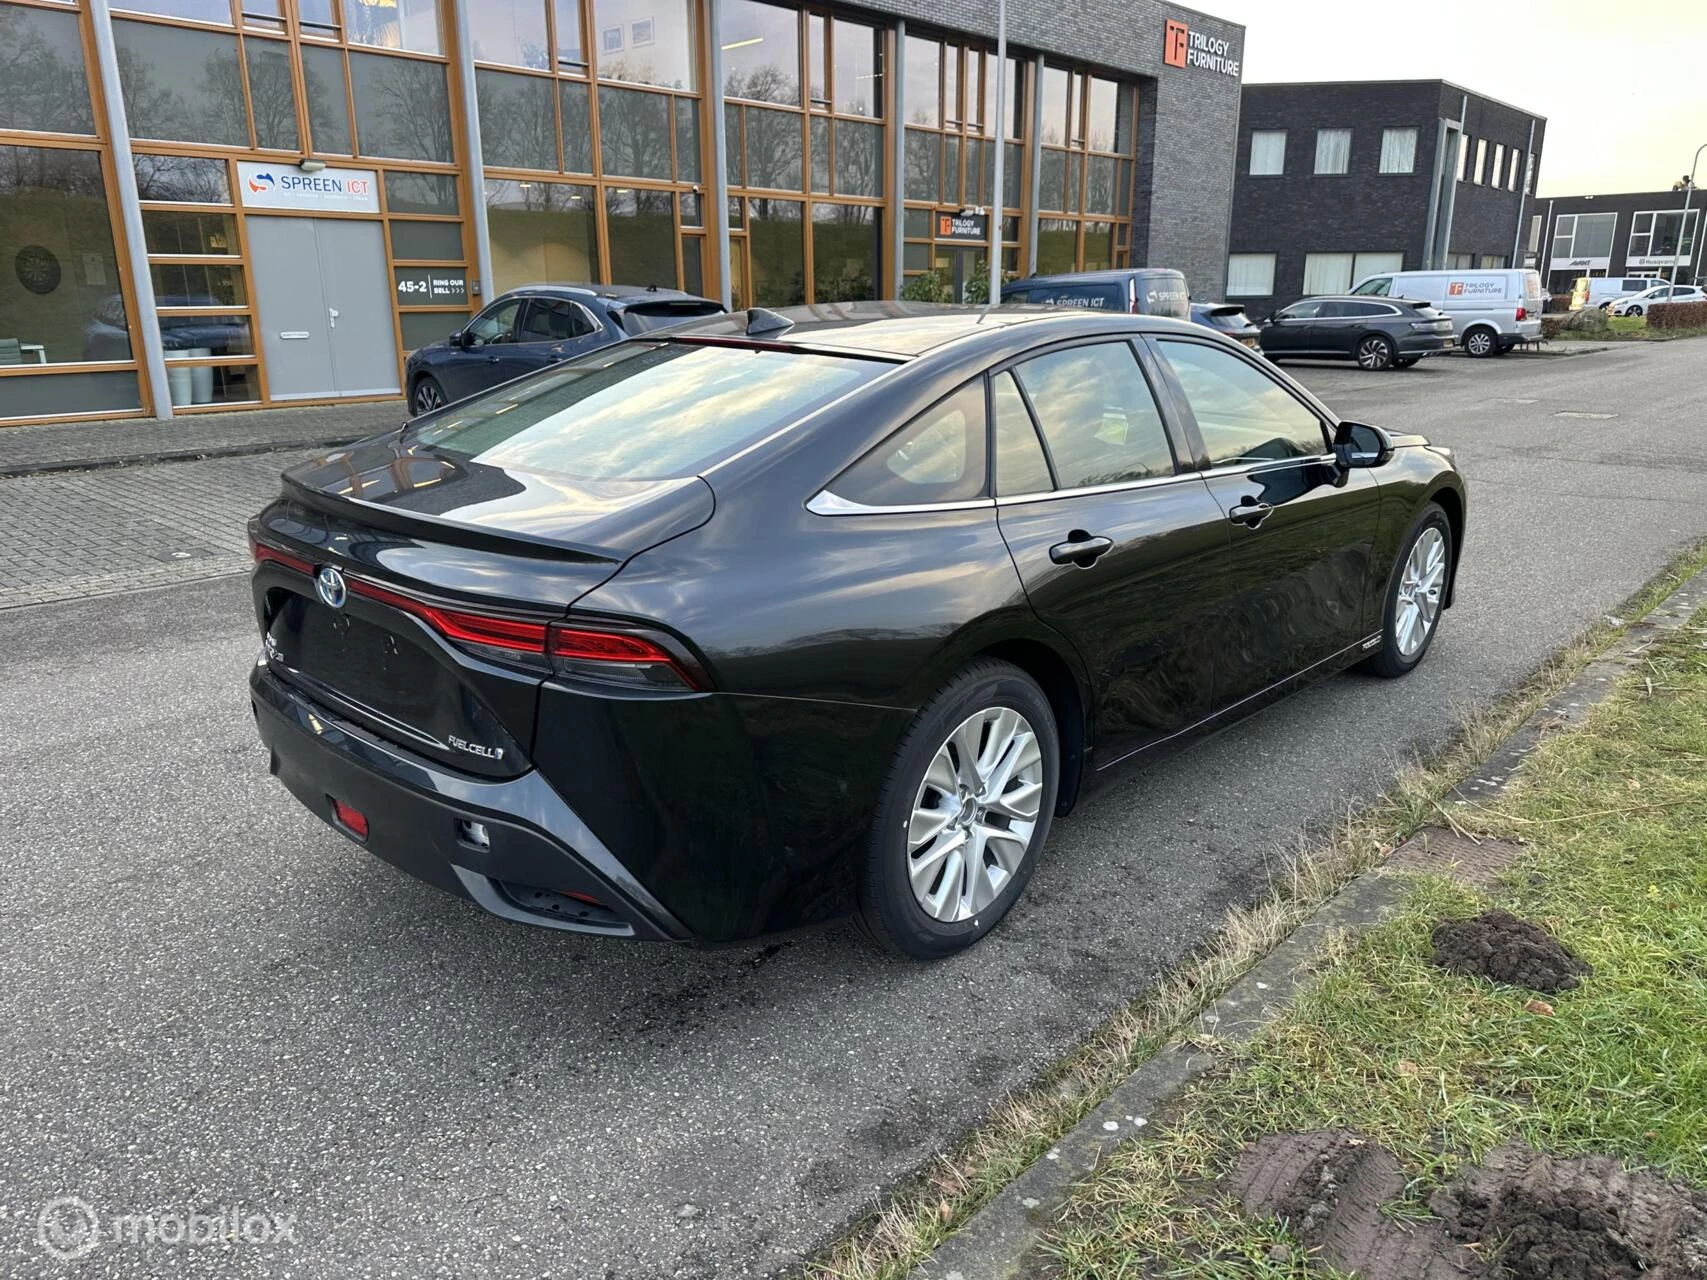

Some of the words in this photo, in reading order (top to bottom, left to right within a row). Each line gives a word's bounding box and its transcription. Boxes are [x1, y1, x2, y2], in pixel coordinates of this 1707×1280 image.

[1188, 31, 1229, 57] TRILOGY
[1187, 49, 1240, 77] FURNITURE
[281, 175, 342, 192] SPREEN
[346, 180, 369, 194] ICT
[952, 218, 974, 227] TRILOGY
[951, 226, 981, 236] FURNITURE
[398, 281, 427, 293] 45-2
[1090, 297, 1104, 307] ICT
